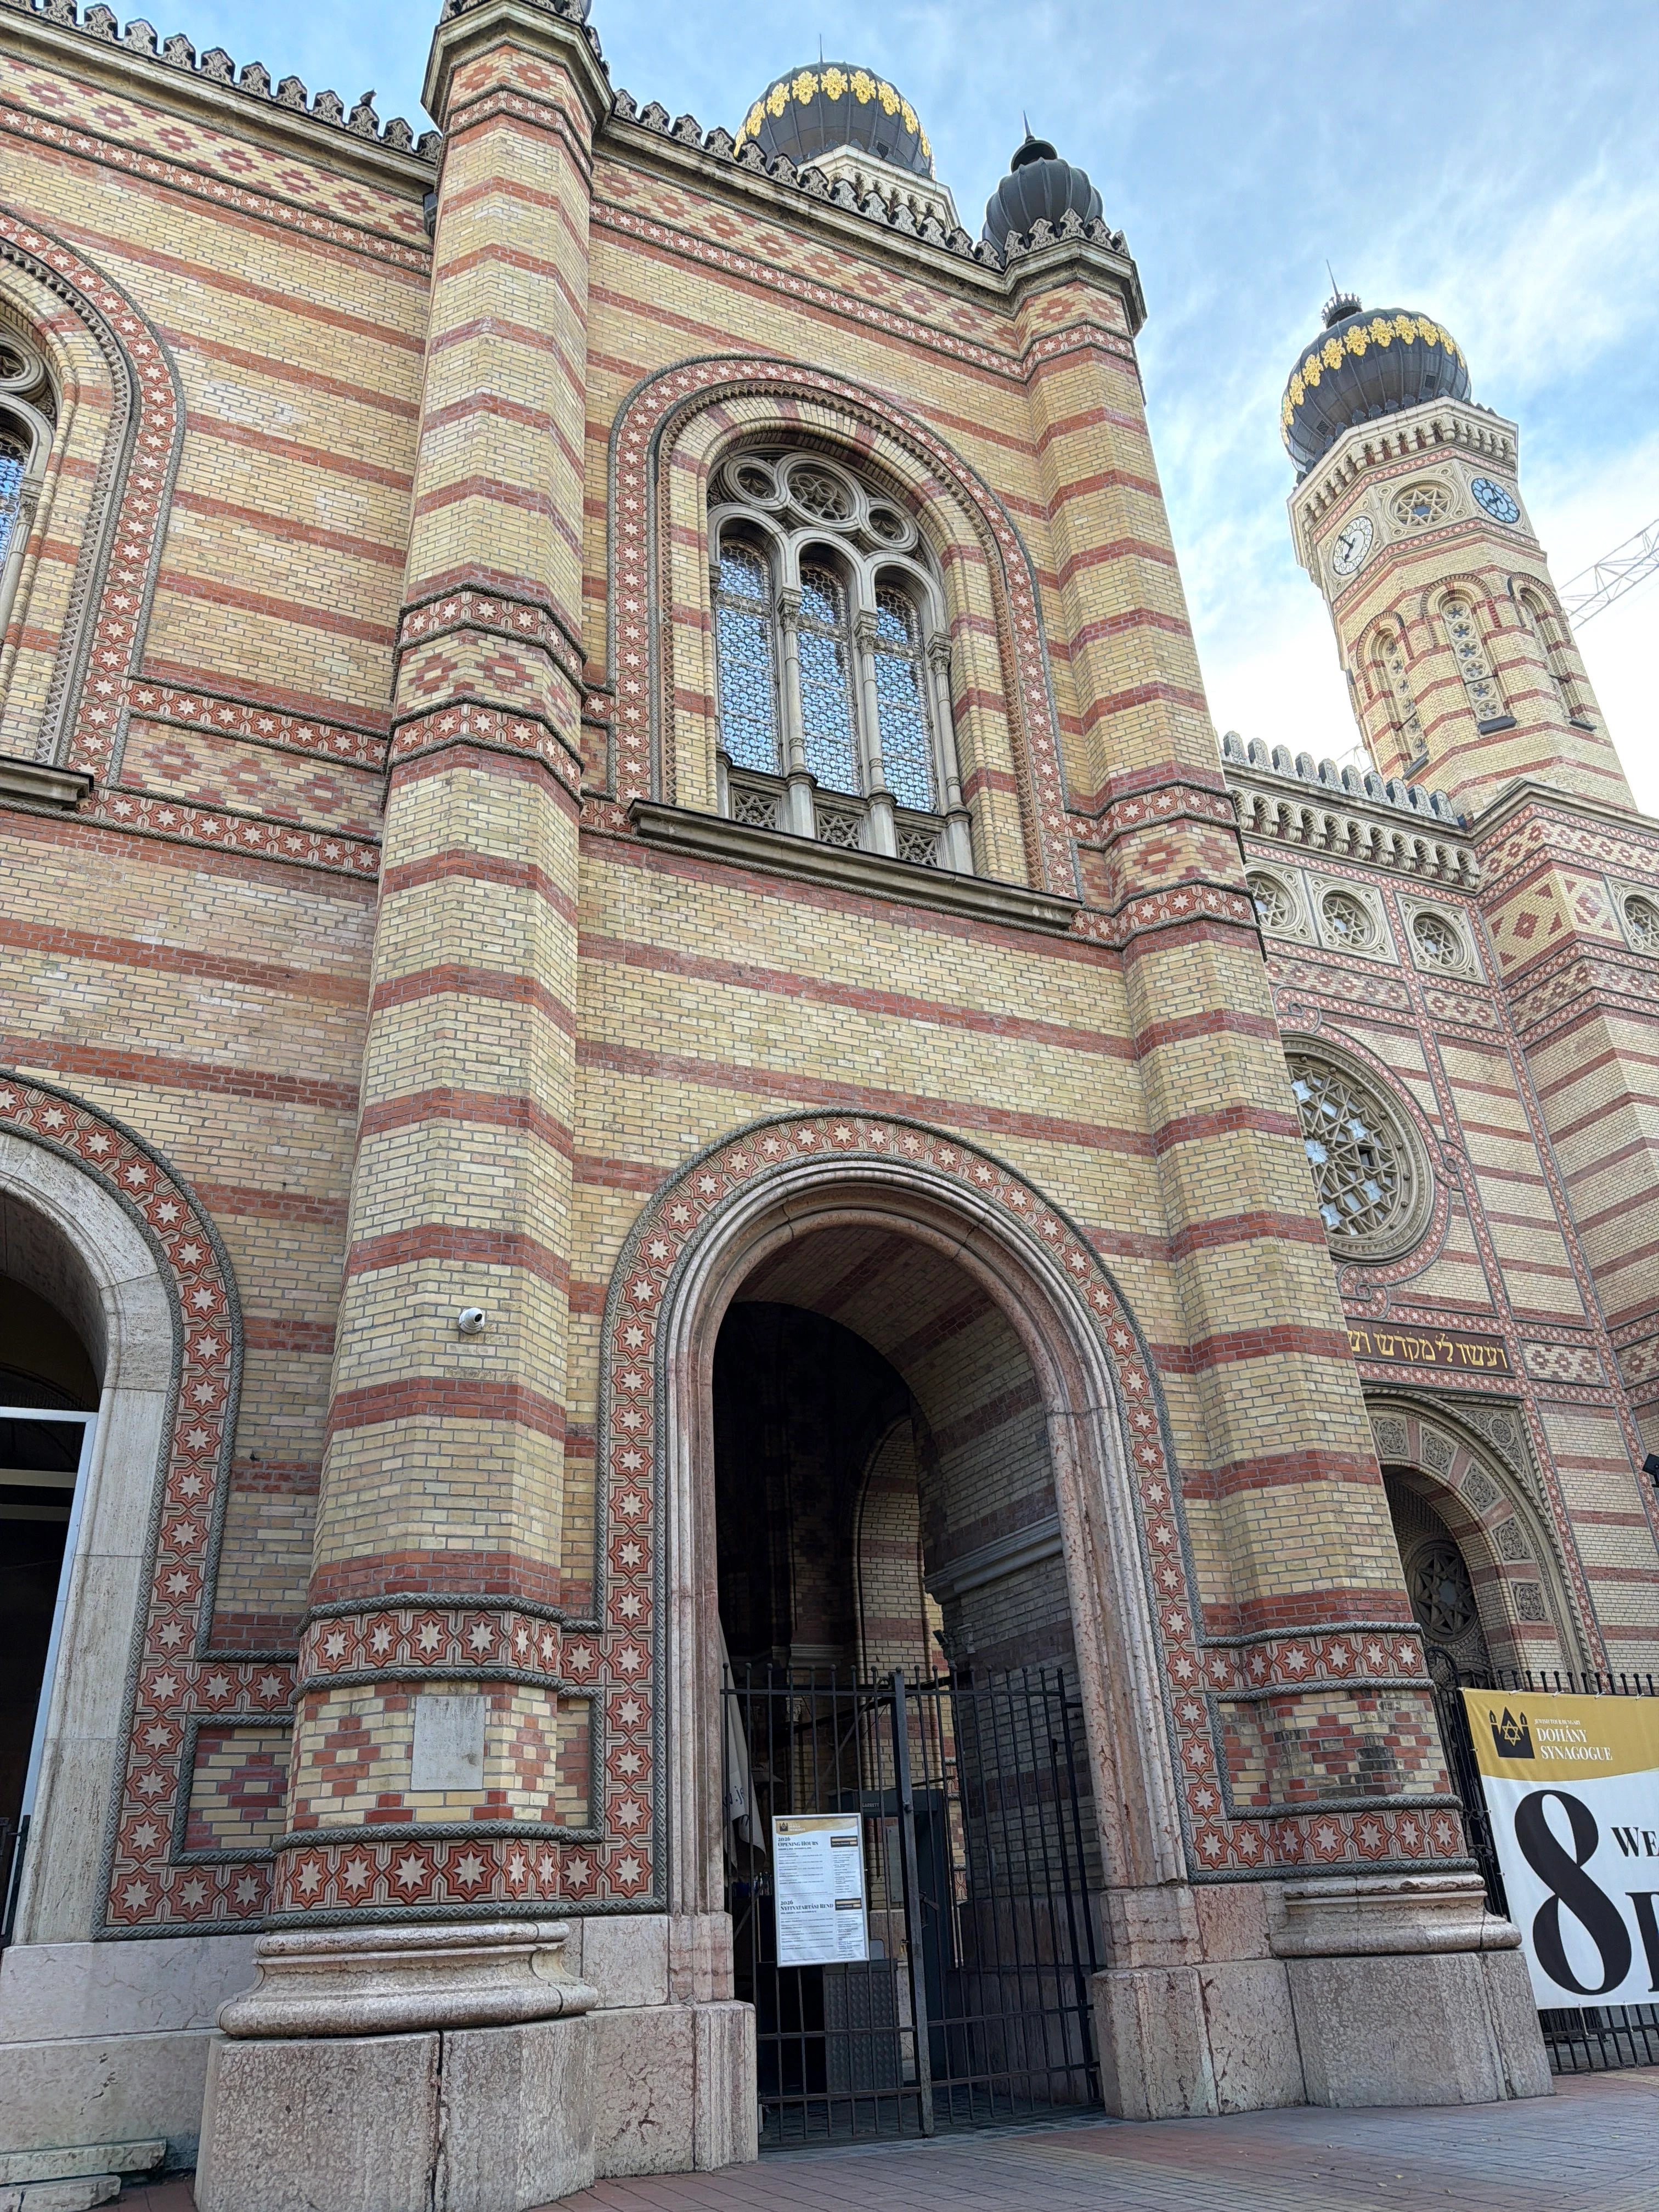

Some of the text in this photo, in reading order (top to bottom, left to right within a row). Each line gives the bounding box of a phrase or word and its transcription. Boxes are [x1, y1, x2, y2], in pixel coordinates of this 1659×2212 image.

[1373, 1328, 1436, 1362] מקדש
[1435, 1333, 1453, 1363] לי
[1455, 1341, 1508, 1369] ועשו
[1536, 1725, 1587, 1742] DOHÁNY
[1540, 1745, 1613, 1760] SYNAGOGUE
[1515, 1790, 1632, 1996] 8
